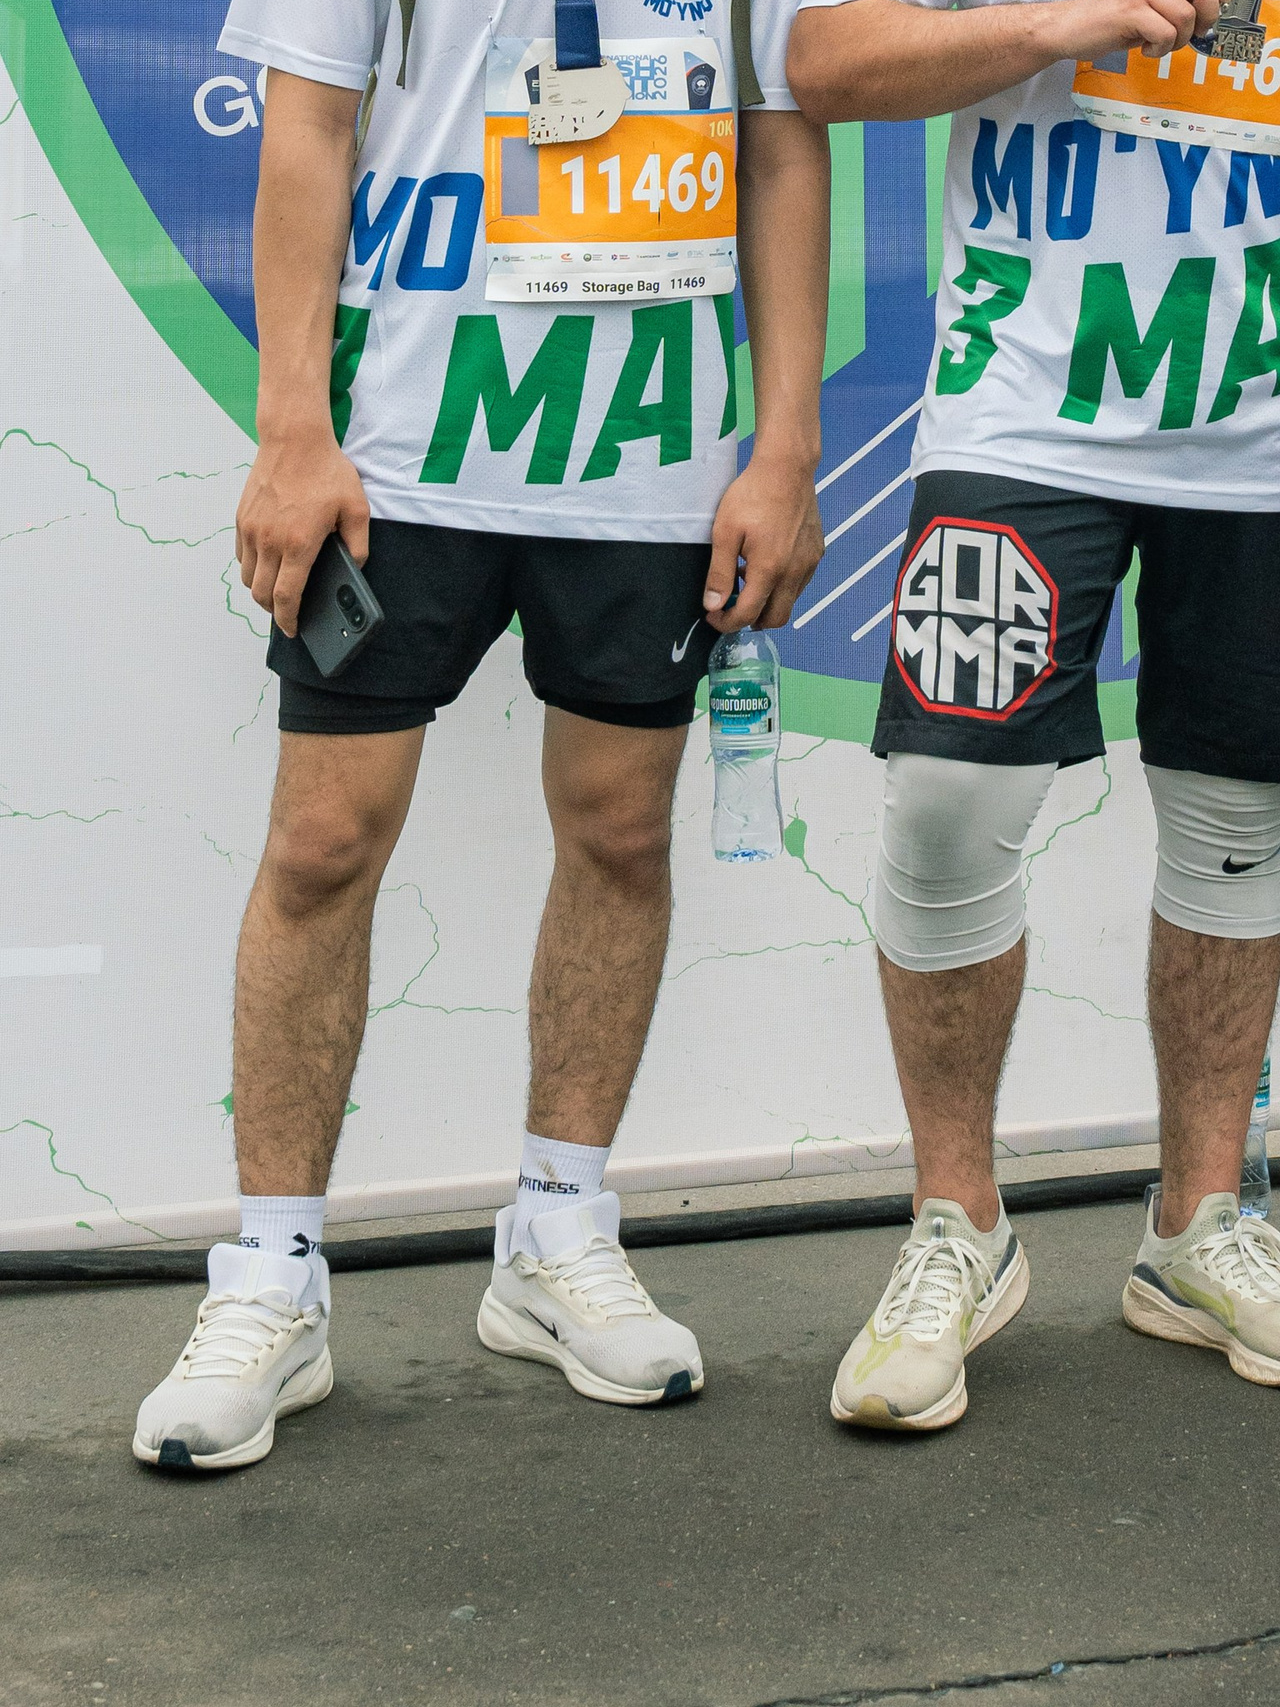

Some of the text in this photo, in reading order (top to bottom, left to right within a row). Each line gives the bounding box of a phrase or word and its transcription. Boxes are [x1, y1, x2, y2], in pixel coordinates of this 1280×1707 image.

[653, 54, 668, 100] 2026
[708, 118, 734, 138] 10K
[561, 151, 725, 214] 11469
[526, 276, 706, 295] 11469 Storage Bag 11469
[936, 244, 1031, 396] 3
[899, 525, 1051, 628] GOR
[895, 614, 1050, 711] MMA
